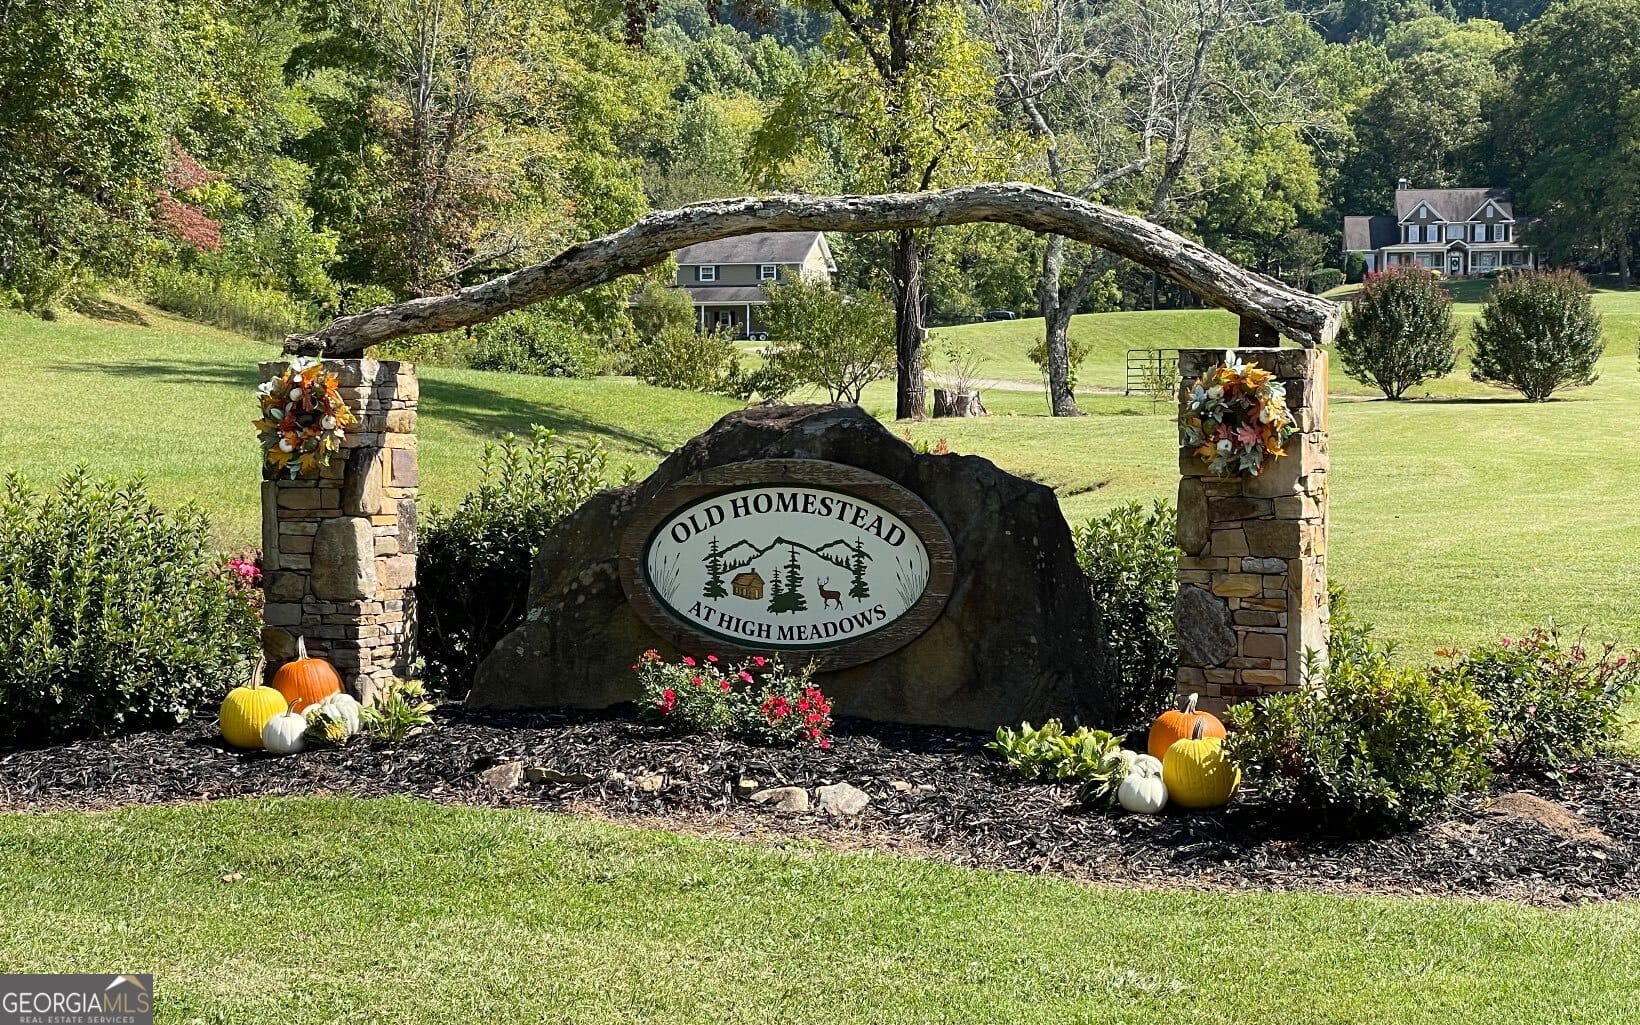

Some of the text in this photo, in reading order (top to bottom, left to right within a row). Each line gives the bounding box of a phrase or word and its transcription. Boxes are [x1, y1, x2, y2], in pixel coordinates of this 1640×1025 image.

[670, 492, 907, 549] OLD HOMESTEAD
[688, 601, 888, 641] AT HIGH MEADOWS
